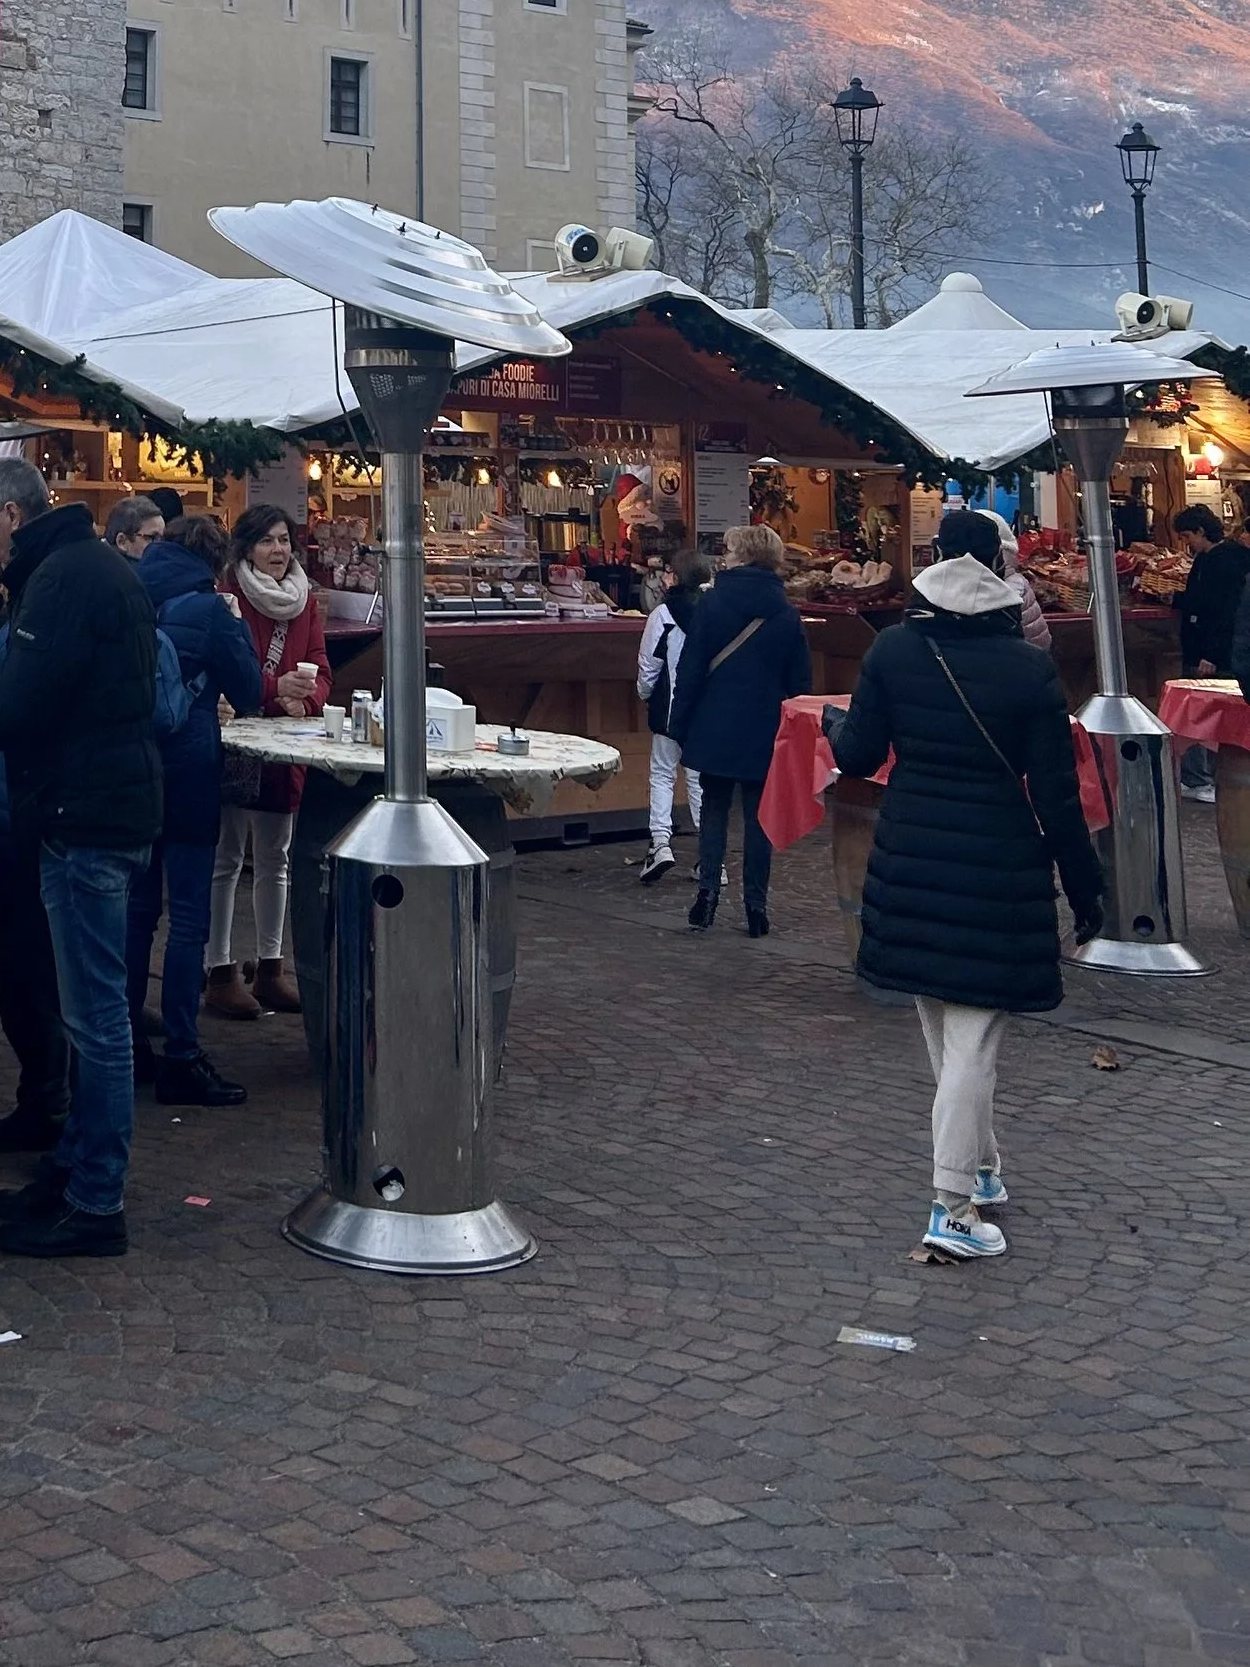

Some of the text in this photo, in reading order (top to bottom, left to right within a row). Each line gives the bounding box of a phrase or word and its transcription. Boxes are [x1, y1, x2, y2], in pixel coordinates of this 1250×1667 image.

[502, 363, 535, 382] FOODIE
[480, 379, 490, 396] DI
[492, 380, 516, 399] CASA
[518, 382, 560, 402] MIORELLI
